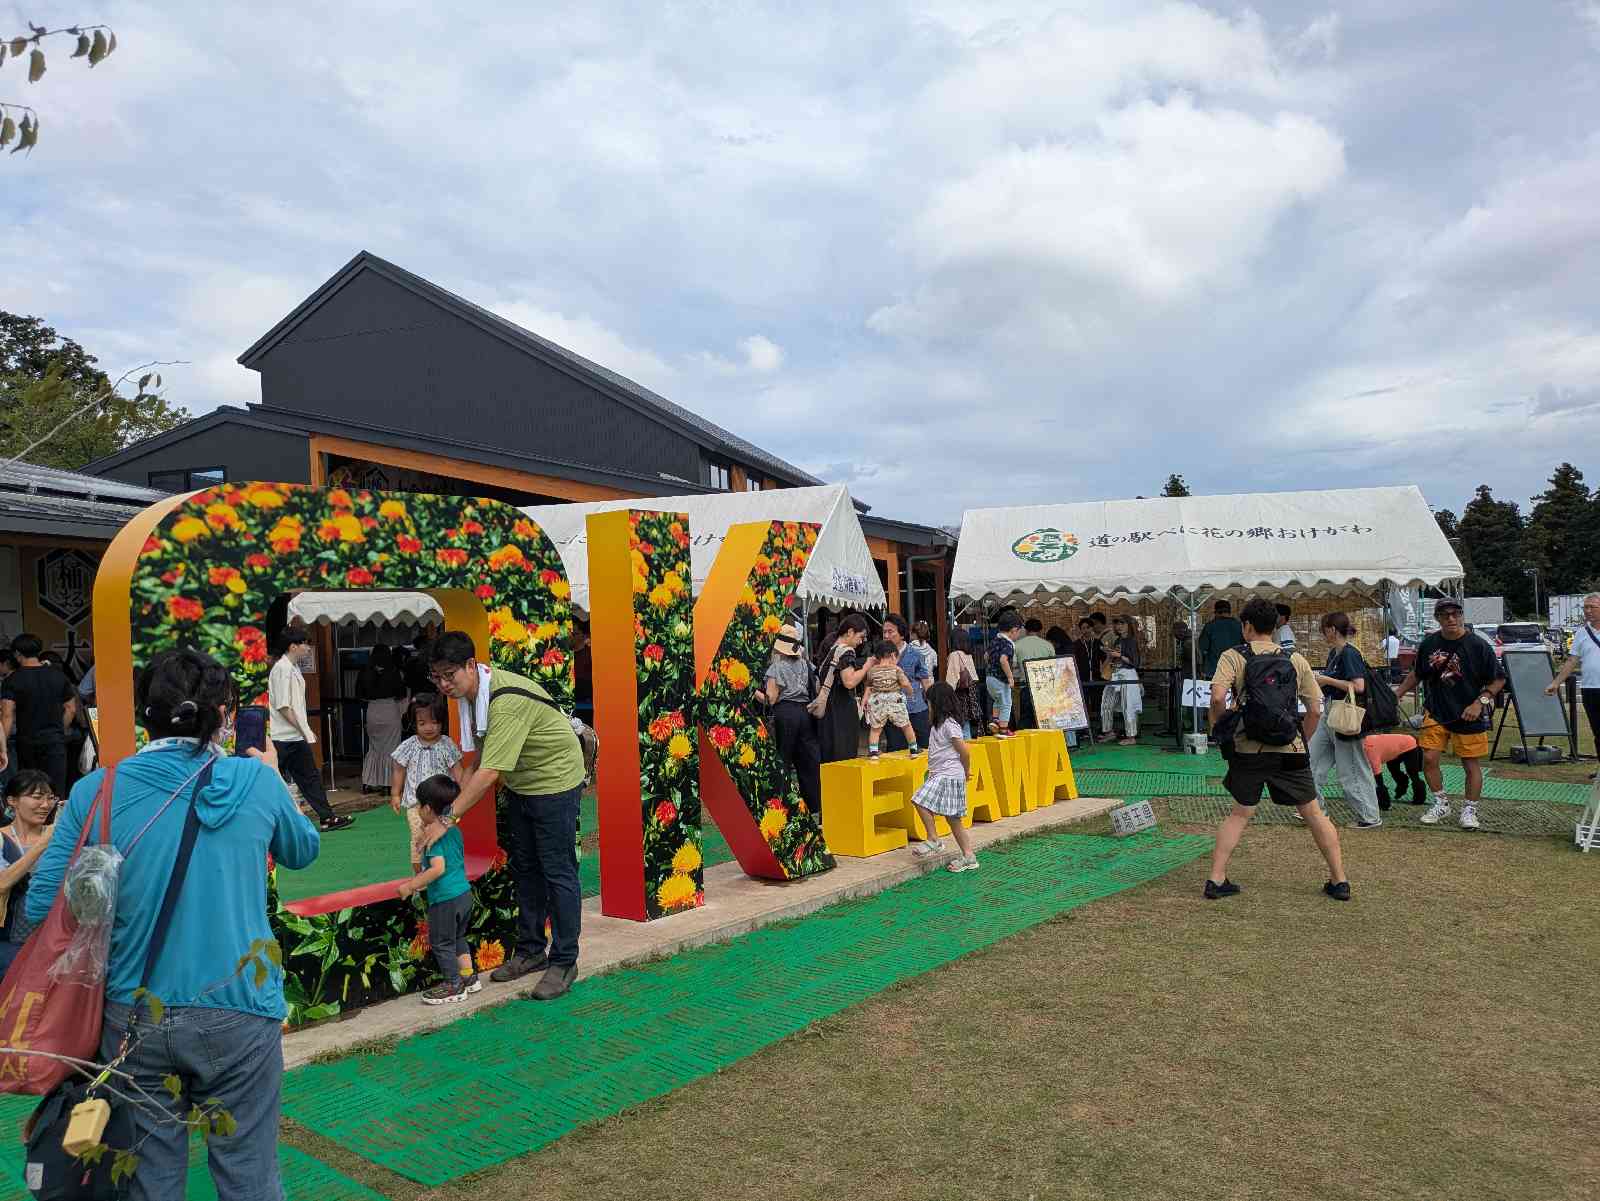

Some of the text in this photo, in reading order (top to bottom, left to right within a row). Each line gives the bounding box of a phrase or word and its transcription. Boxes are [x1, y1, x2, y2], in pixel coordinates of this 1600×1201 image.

[1088, 525, 1374, 548] 道の駅べに花の郷おけがわ
